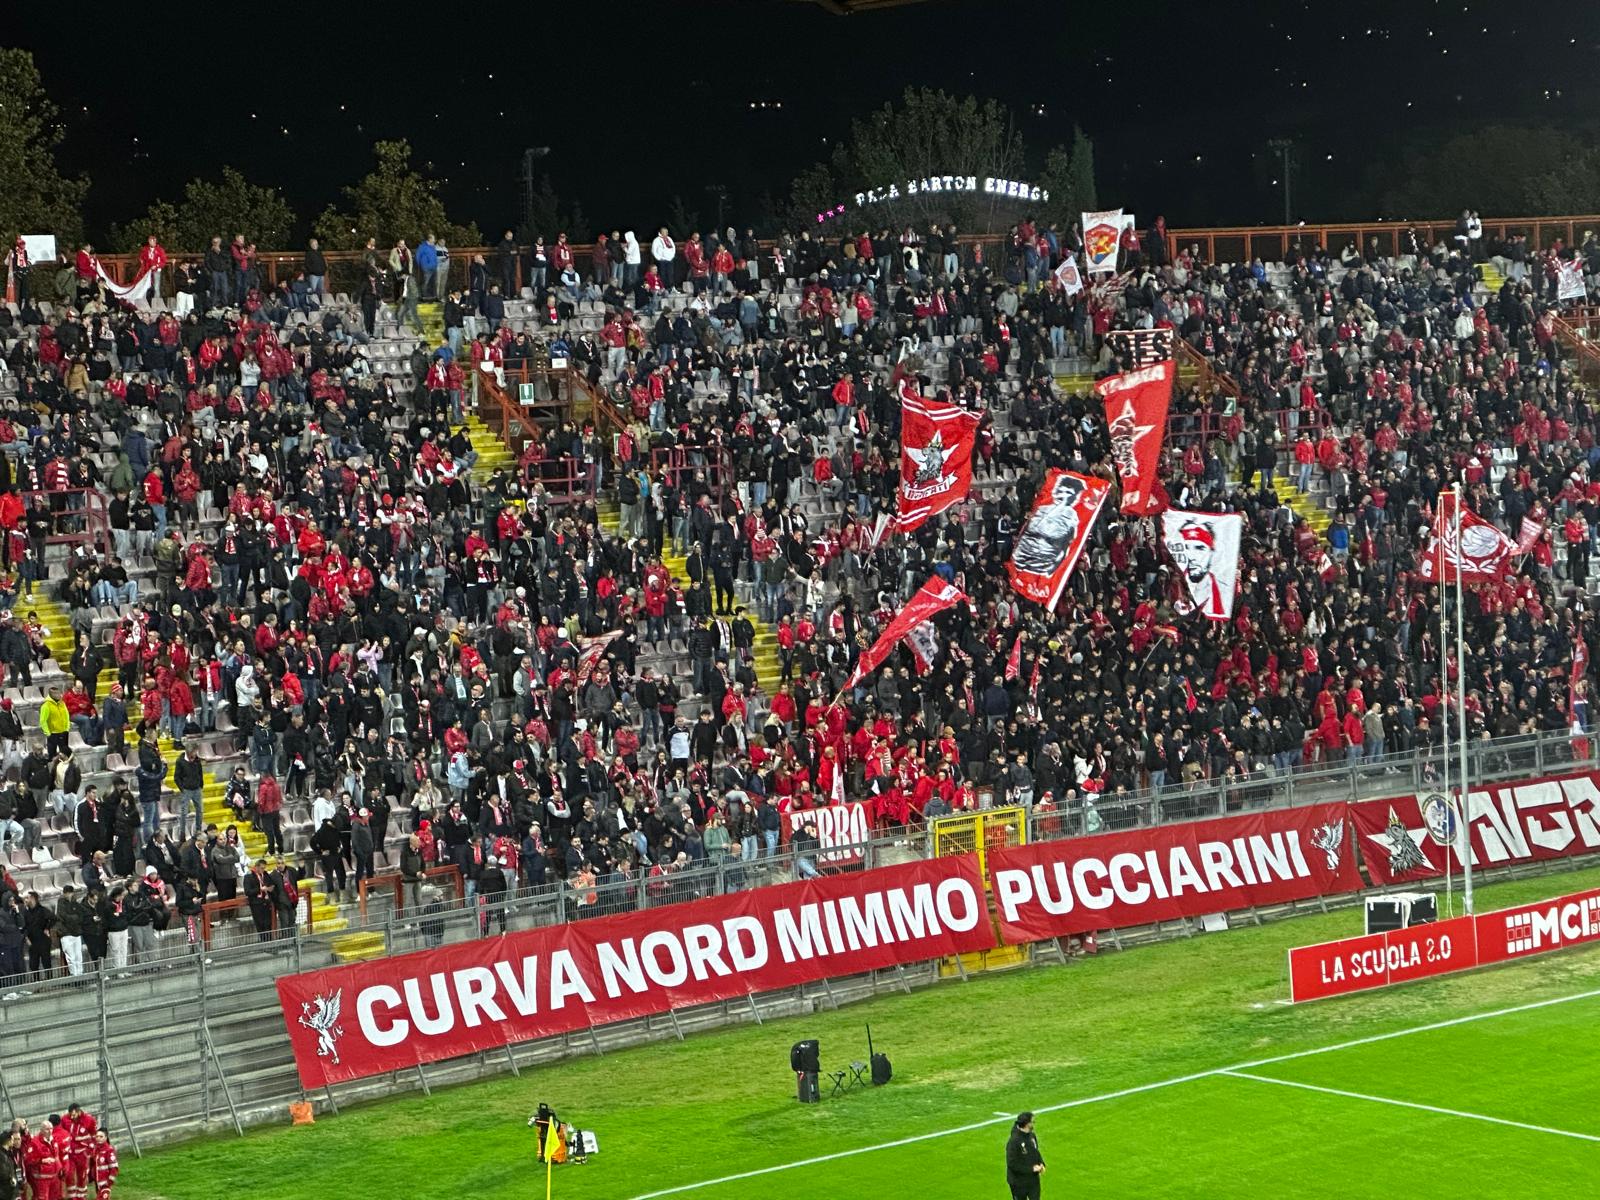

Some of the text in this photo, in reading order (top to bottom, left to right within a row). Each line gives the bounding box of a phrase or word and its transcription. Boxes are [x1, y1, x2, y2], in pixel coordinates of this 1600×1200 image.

[356, 829, 1311, 1048] CURVA NORD MIMMO PUCCIARINI
[1531, 900, 1590, 948] MCI
[1321, 935, 1452, 983] LA SCUOLA 2.0
